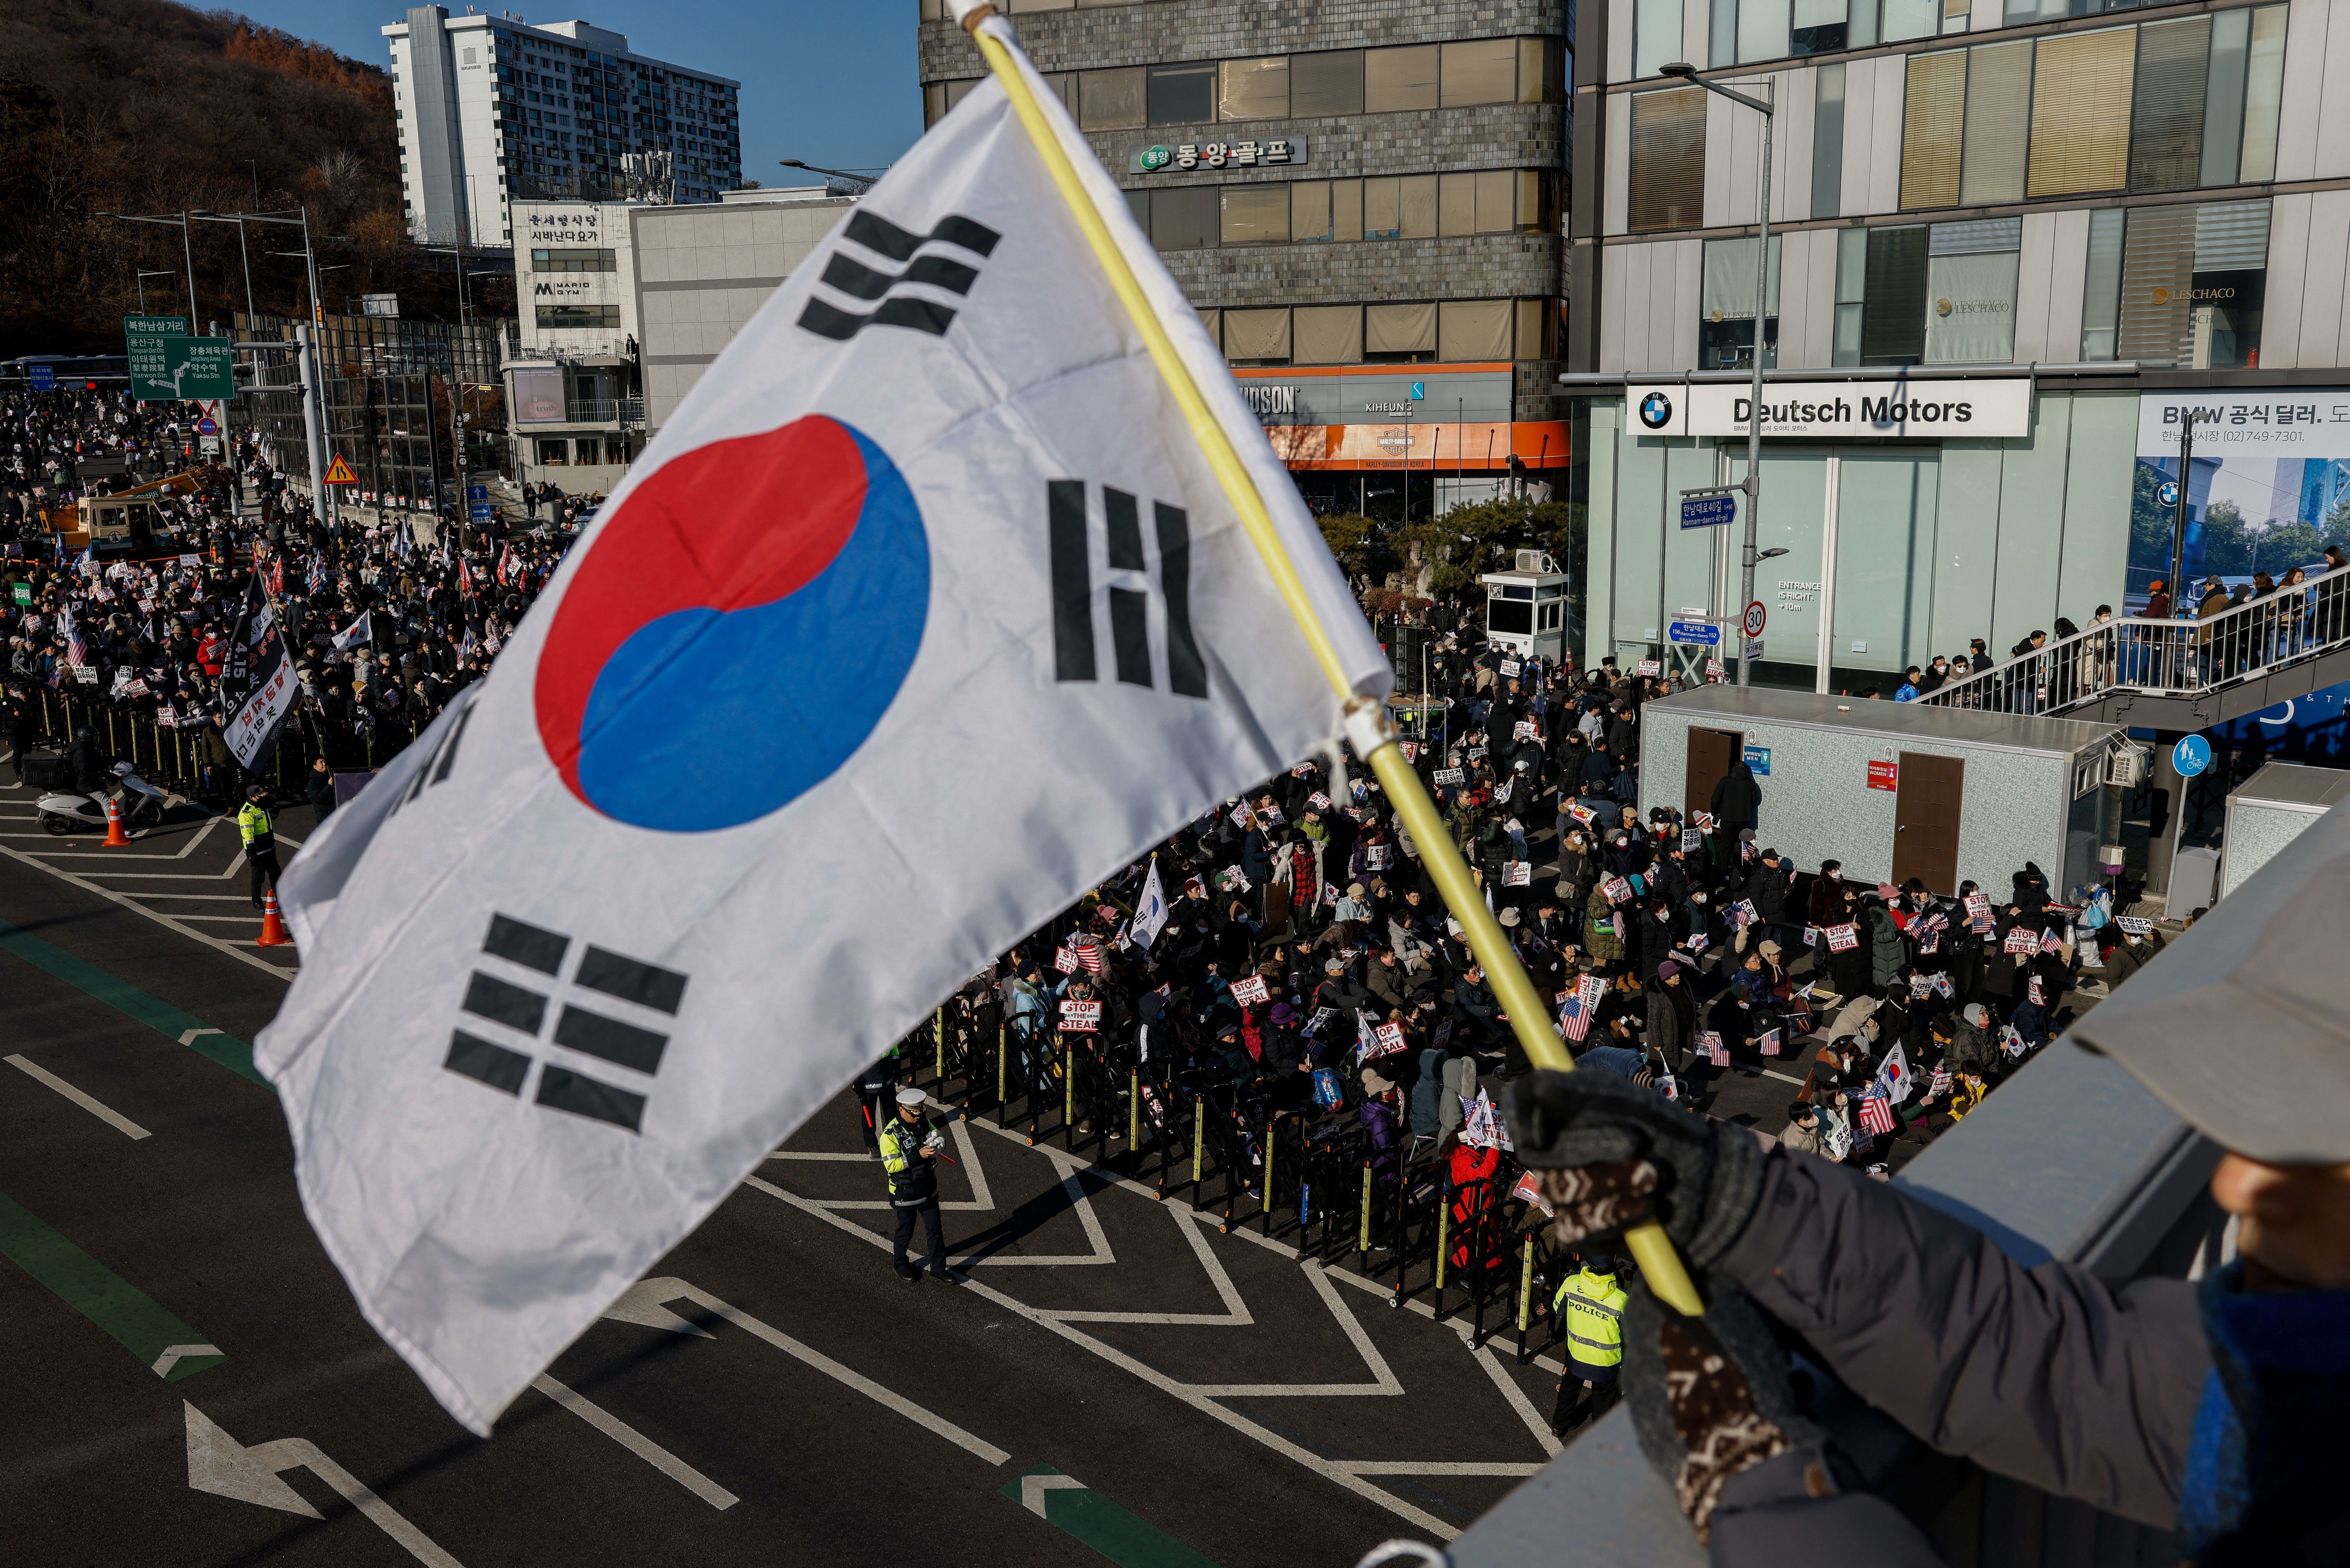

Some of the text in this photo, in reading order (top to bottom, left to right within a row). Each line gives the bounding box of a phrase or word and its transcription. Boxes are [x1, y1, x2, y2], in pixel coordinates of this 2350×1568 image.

[1148, 152, 1169, 163] 동양
[1177, 140, 1289, 168] 동양골프
[532, 231, 597, 242] 시바난다요가
[2172, 288, 2234, 300] LESCHACO
[1954, 299, 2008, 310] LESCHACO
[128, 320, 184, 332] 북한남삼거리
[130, 338, 164, 347] 용산구청
[190, 347, 228, 355] 장충체육관
[132, 355, 165, 363] 이태원역
[191, 363, 217, 372] 약수역
[1643, 393, 1670, 405] BMW
[1366, 403, 1412, 412] KIHEUNG
[1734, 397, 1972, 423] Deutsch Motors
[2229, 405, 2269, 425] 공식
[2276, 405, 2322, 424] 딜러.
[1683, 514, 1728, 526] Hannam-daero 40-gil
[1779, 581, 1822, 590] ENTRANCE
[1785, 603, 1801, 611] 10m
[1748, 611, 1762, 627] 30
[1746, 643, 1763, 654] 여기부터
[127, 681, 141, 690] STOP
[1236, 805, 1246, 816] STOP
[1240, 811, 1251, 823] STEAL
[1607, 879, 1625, 892] STOP
[1970, 896, 1989, 905] STOP
[1830, 925, 1850, 936] STOP
[2010, 930, 2035, 938] STOP
[1831, 939, 1856, 950] STEAL
[1236, 979, 1258, 992] STOP
[1240, 993, 1267, 1006] STEAL
[1066, 1004, 1095, 1013] STOP
[1857, 1126, 1873, 1138] STOP
[1569, 1300, 1609, 1321] POLICE
